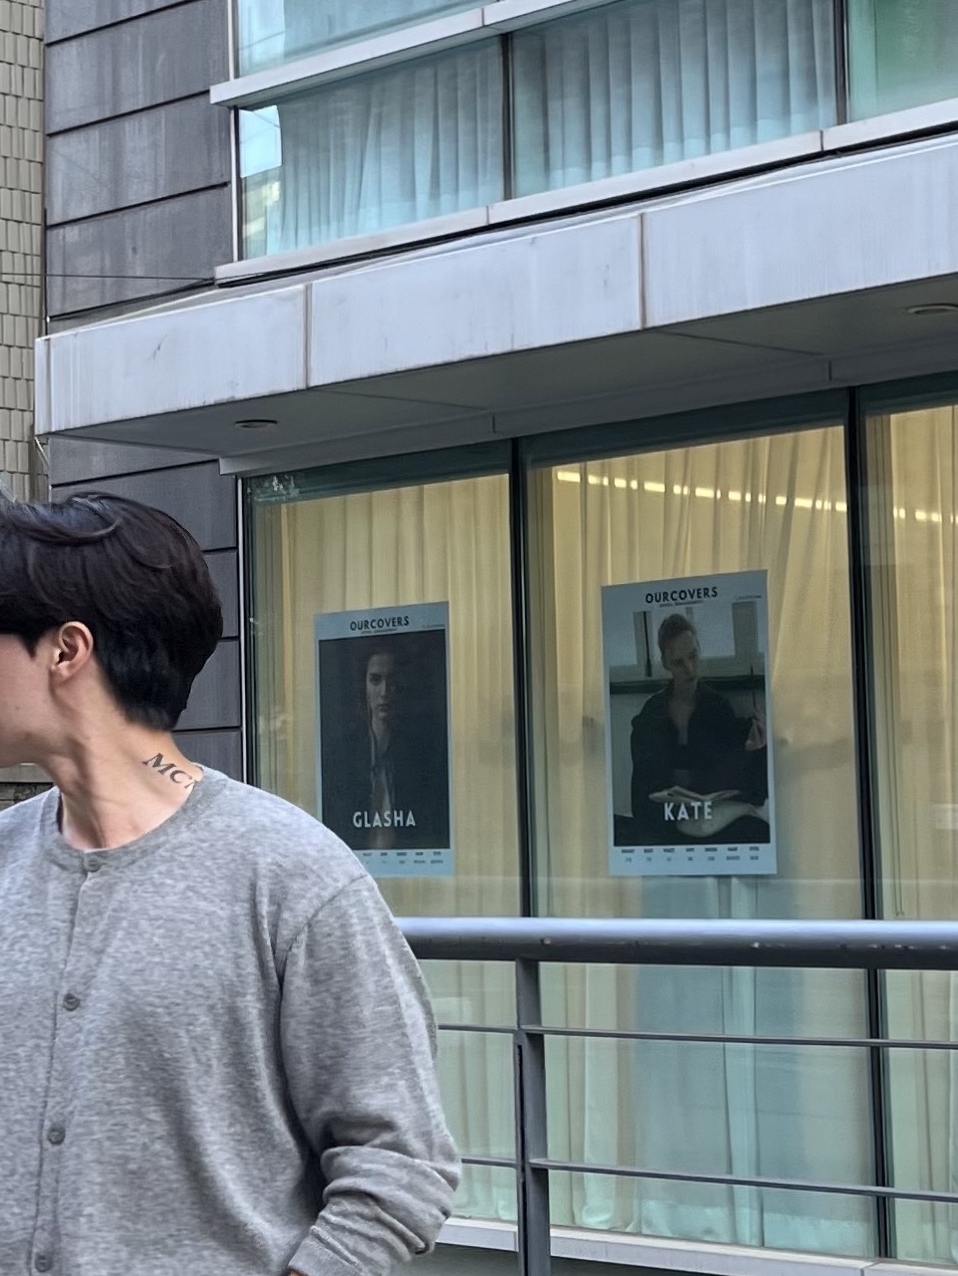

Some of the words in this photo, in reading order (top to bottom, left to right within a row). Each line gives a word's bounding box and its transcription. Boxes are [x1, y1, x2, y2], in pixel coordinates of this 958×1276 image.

[645, 586, 719, 604] OURCOVERS
[350, 615, 410, 631] OURCOVERS
[352, 809, 416, 828] GLASHA
[663, 800, 713, 821] KATE
